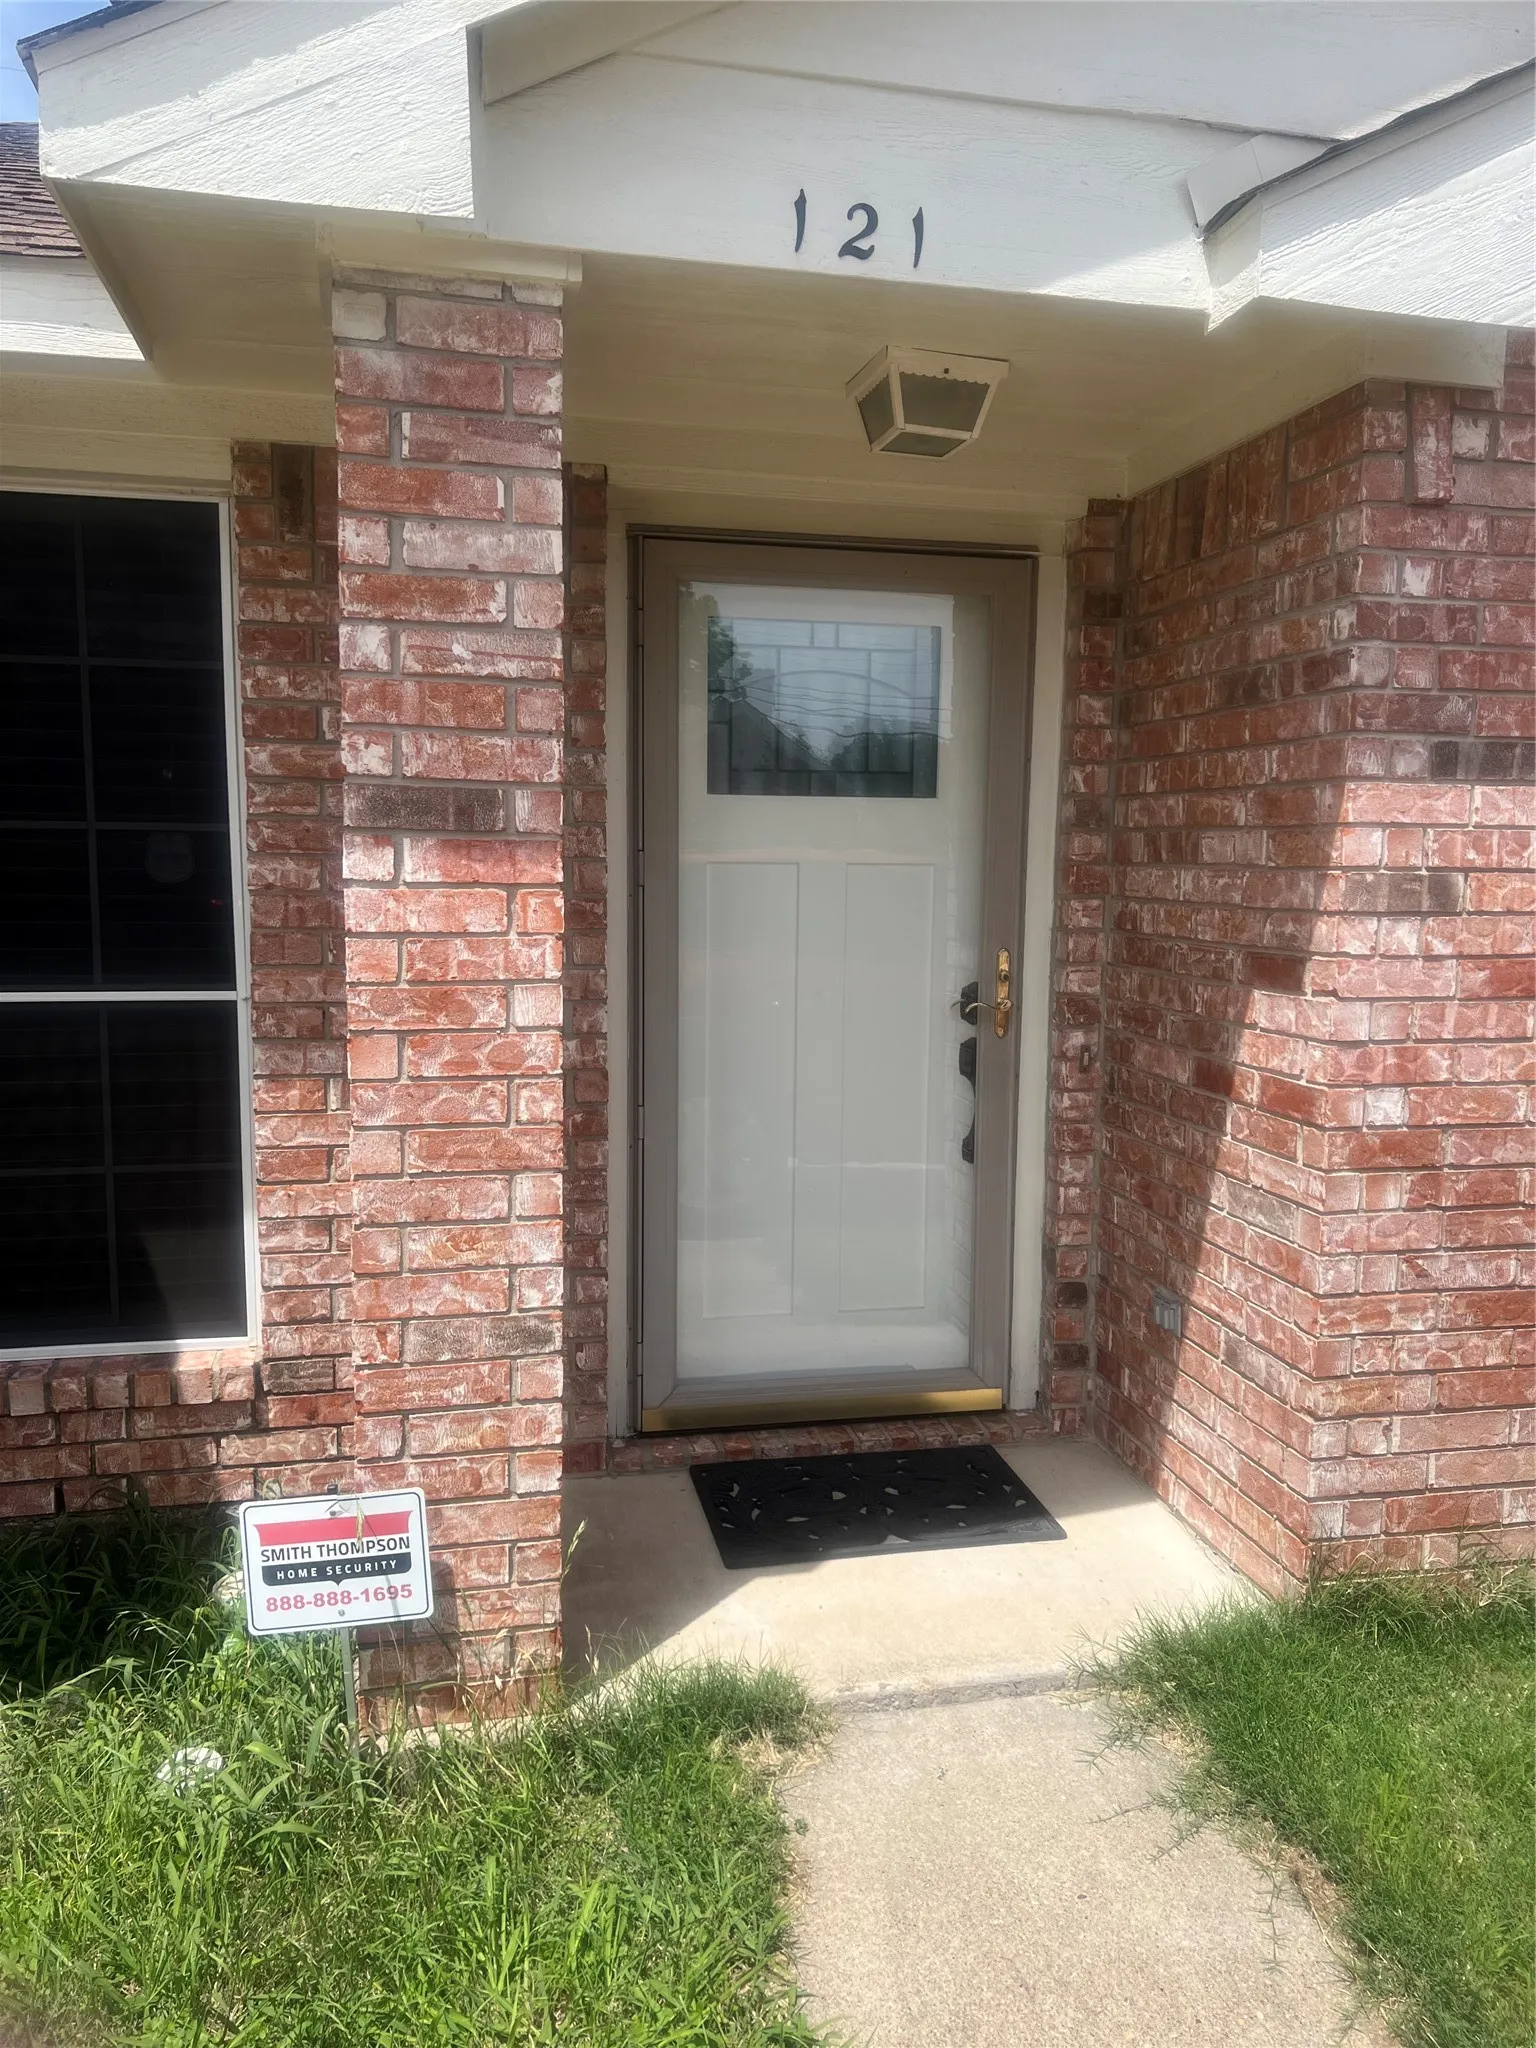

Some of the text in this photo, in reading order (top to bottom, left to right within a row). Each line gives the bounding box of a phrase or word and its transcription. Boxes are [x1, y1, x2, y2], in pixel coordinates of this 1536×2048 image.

[794, 188, 924, 268] 121
[261, 1536, 410, 1562] SMITH THOMPSON
[276, 1559, 397, 1580] HOME SECURITY
[266, 1584, 413, 1612] 888-888-1695
